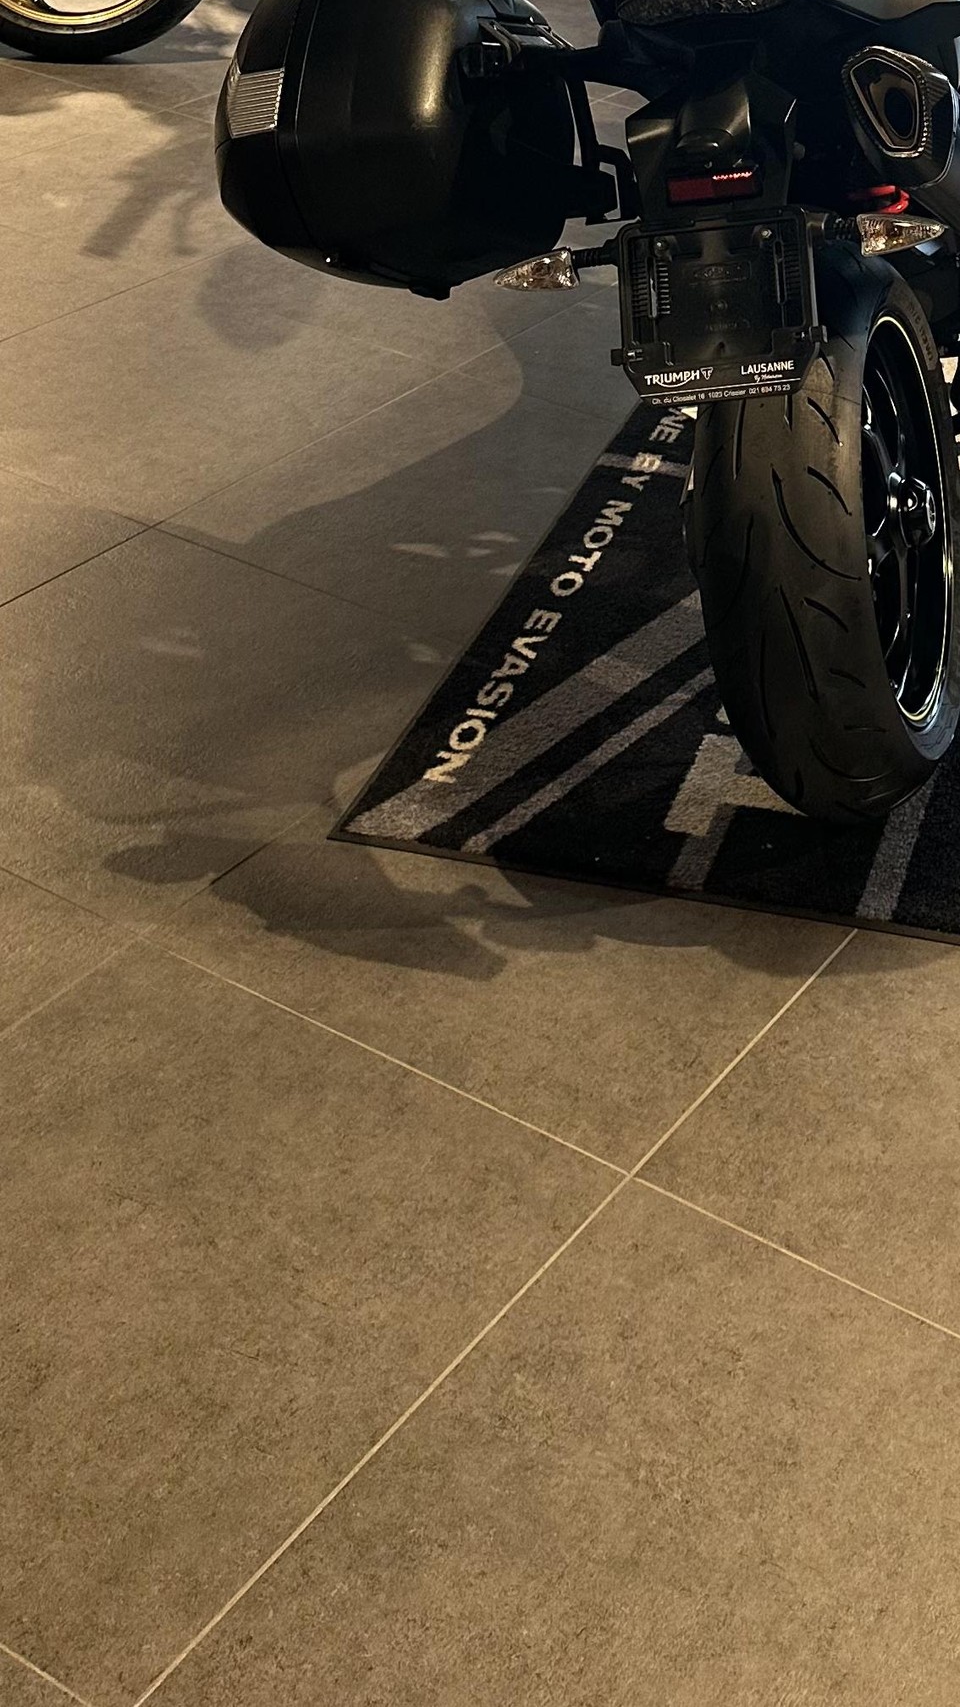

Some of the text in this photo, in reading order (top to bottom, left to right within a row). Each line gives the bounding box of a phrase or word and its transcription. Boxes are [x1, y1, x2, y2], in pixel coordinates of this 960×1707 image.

[644, 360, 795, 388] TRIUMPH LAUSANNE
[423, 452, 664, 784] BY MOTO EVASION
